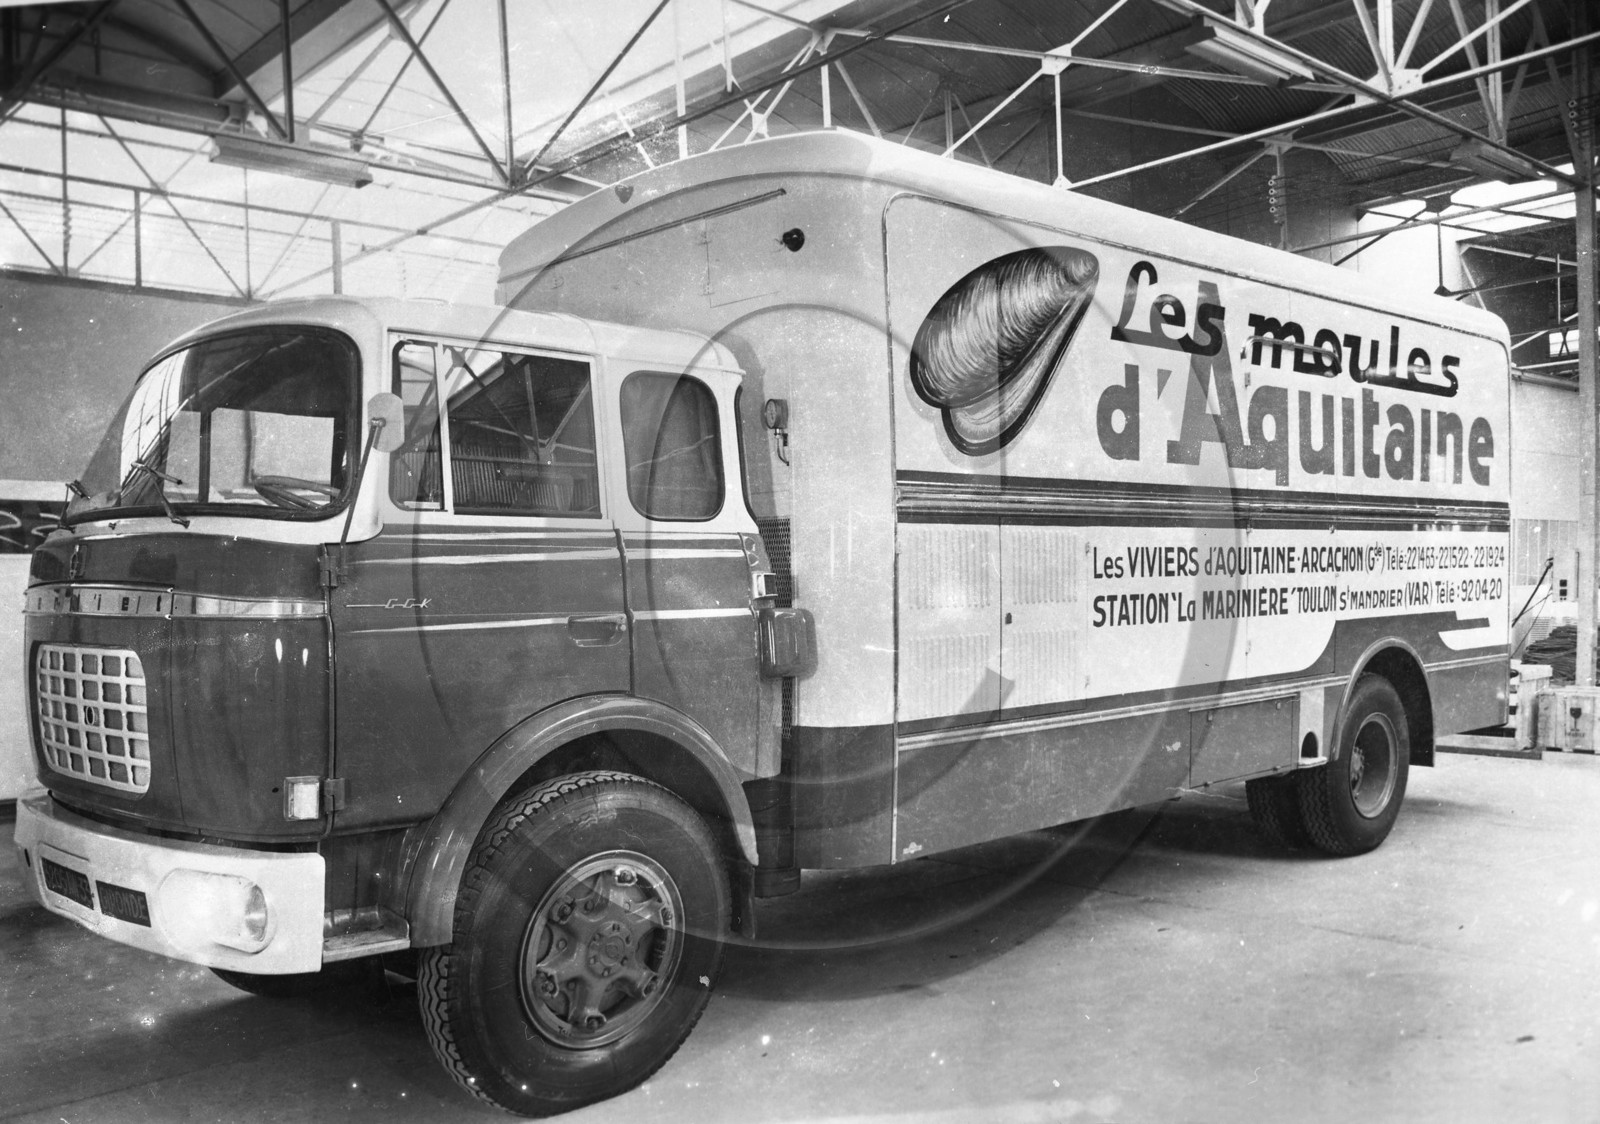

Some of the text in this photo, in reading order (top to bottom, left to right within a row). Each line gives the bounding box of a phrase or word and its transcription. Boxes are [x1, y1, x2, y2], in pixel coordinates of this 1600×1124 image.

[1111, 260, 1460, 398] Les moules
[1093, 546, 1124, 579] Les
[1127, 546, 1199, 578] VIVIERS
[1093, 593, 1168, 628] STATION
[1297, 586, 1337, 613] TOULON
[1404, 579, 1433, 611] (VAR)
